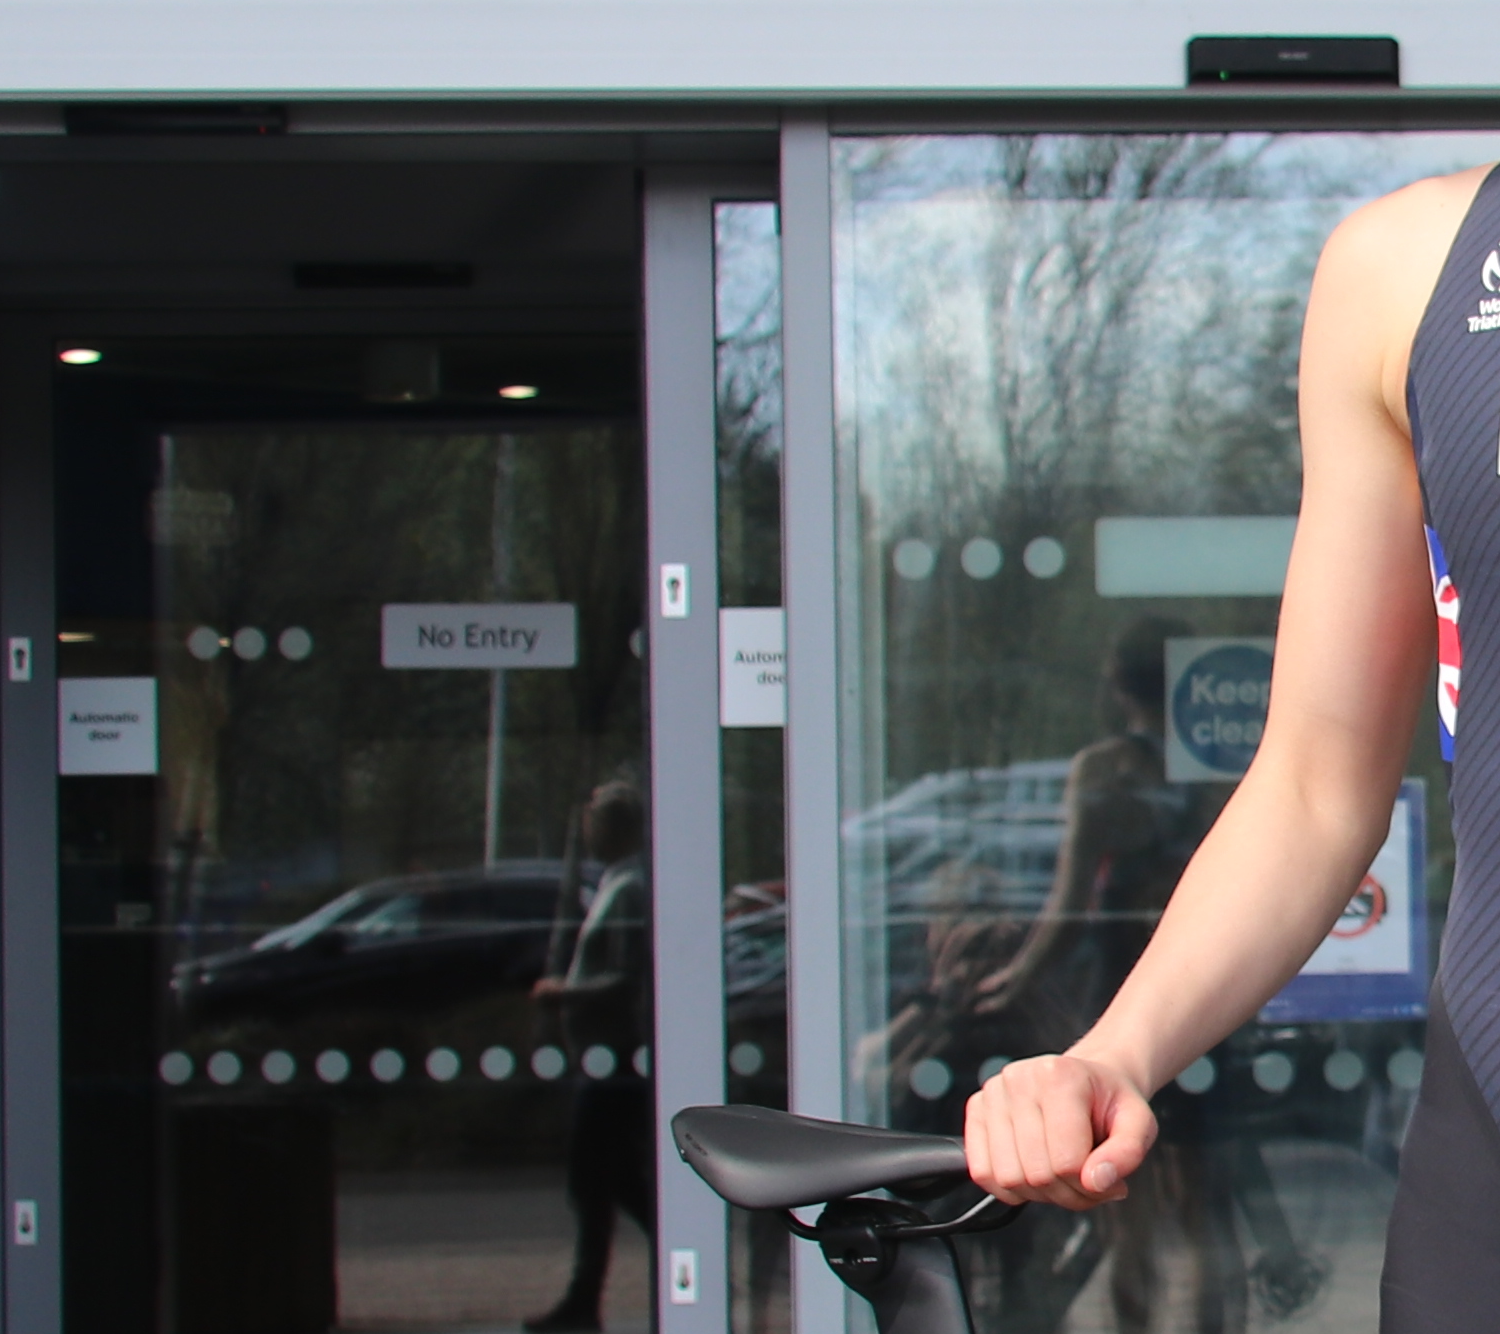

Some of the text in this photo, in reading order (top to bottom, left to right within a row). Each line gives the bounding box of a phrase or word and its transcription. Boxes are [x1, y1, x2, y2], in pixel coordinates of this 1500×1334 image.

[418, 622, 538, 654] No Entry
[733, 650, 787, 664] Autom
[69, 712, 139, 724] Automatic
[88, 729, 121, 742] door
[1191, 715, 1263, 746] clea
